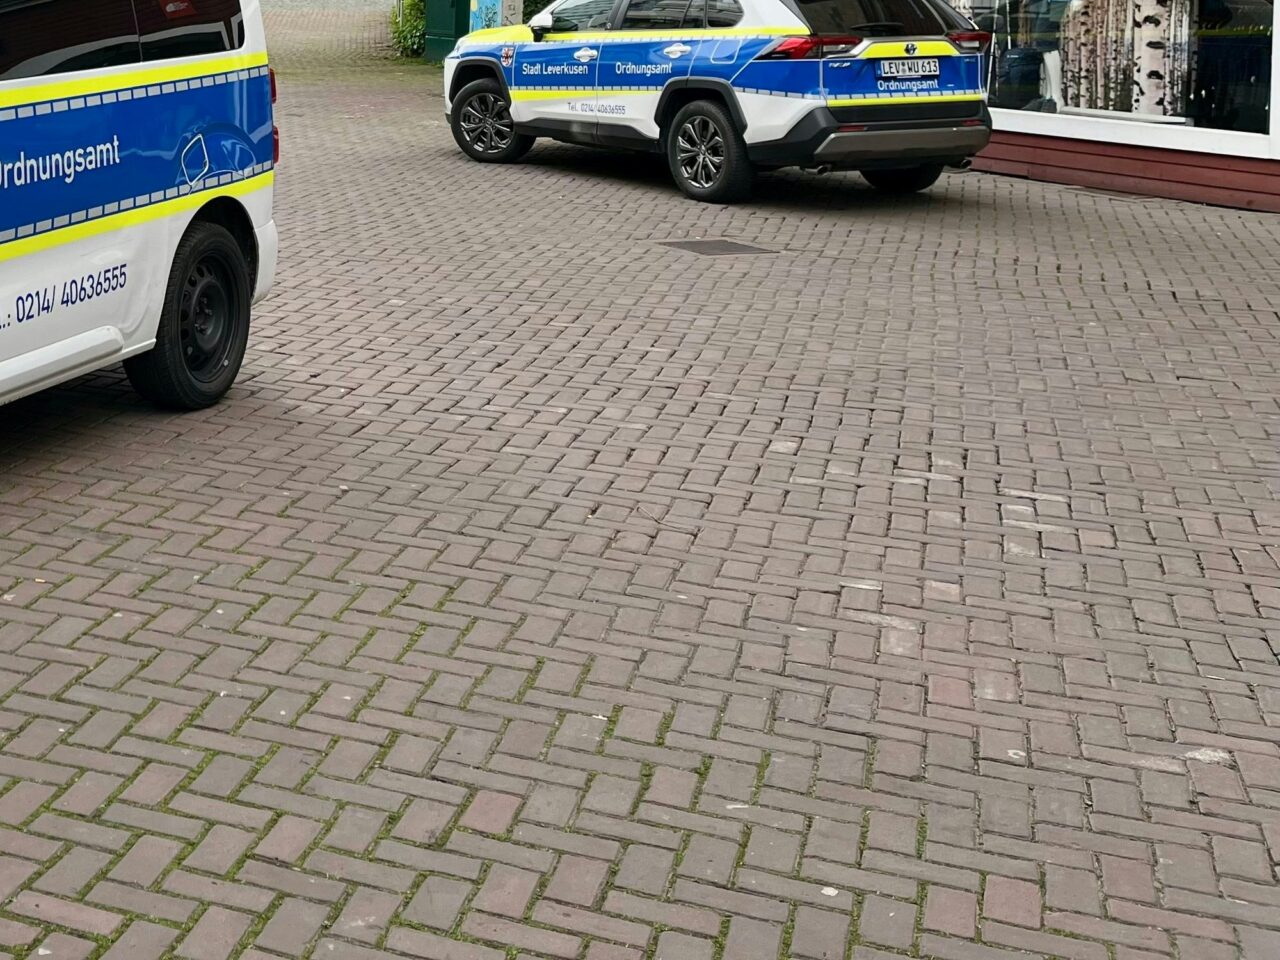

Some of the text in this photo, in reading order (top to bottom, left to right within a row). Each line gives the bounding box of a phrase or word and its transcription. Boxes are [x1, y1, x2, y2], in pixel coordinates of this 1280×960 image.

[521, 62, 589, 75] Stadt Leverkusen
[615, 61, 673, 77] Ordnungsamt
[882, 60, 938, 75] LEV WU 613
[877, 79, 939, 92] Ordnungsamt
[15, 291, 57, 325] 0214/
[61, 264, 128, 308] 40636555
